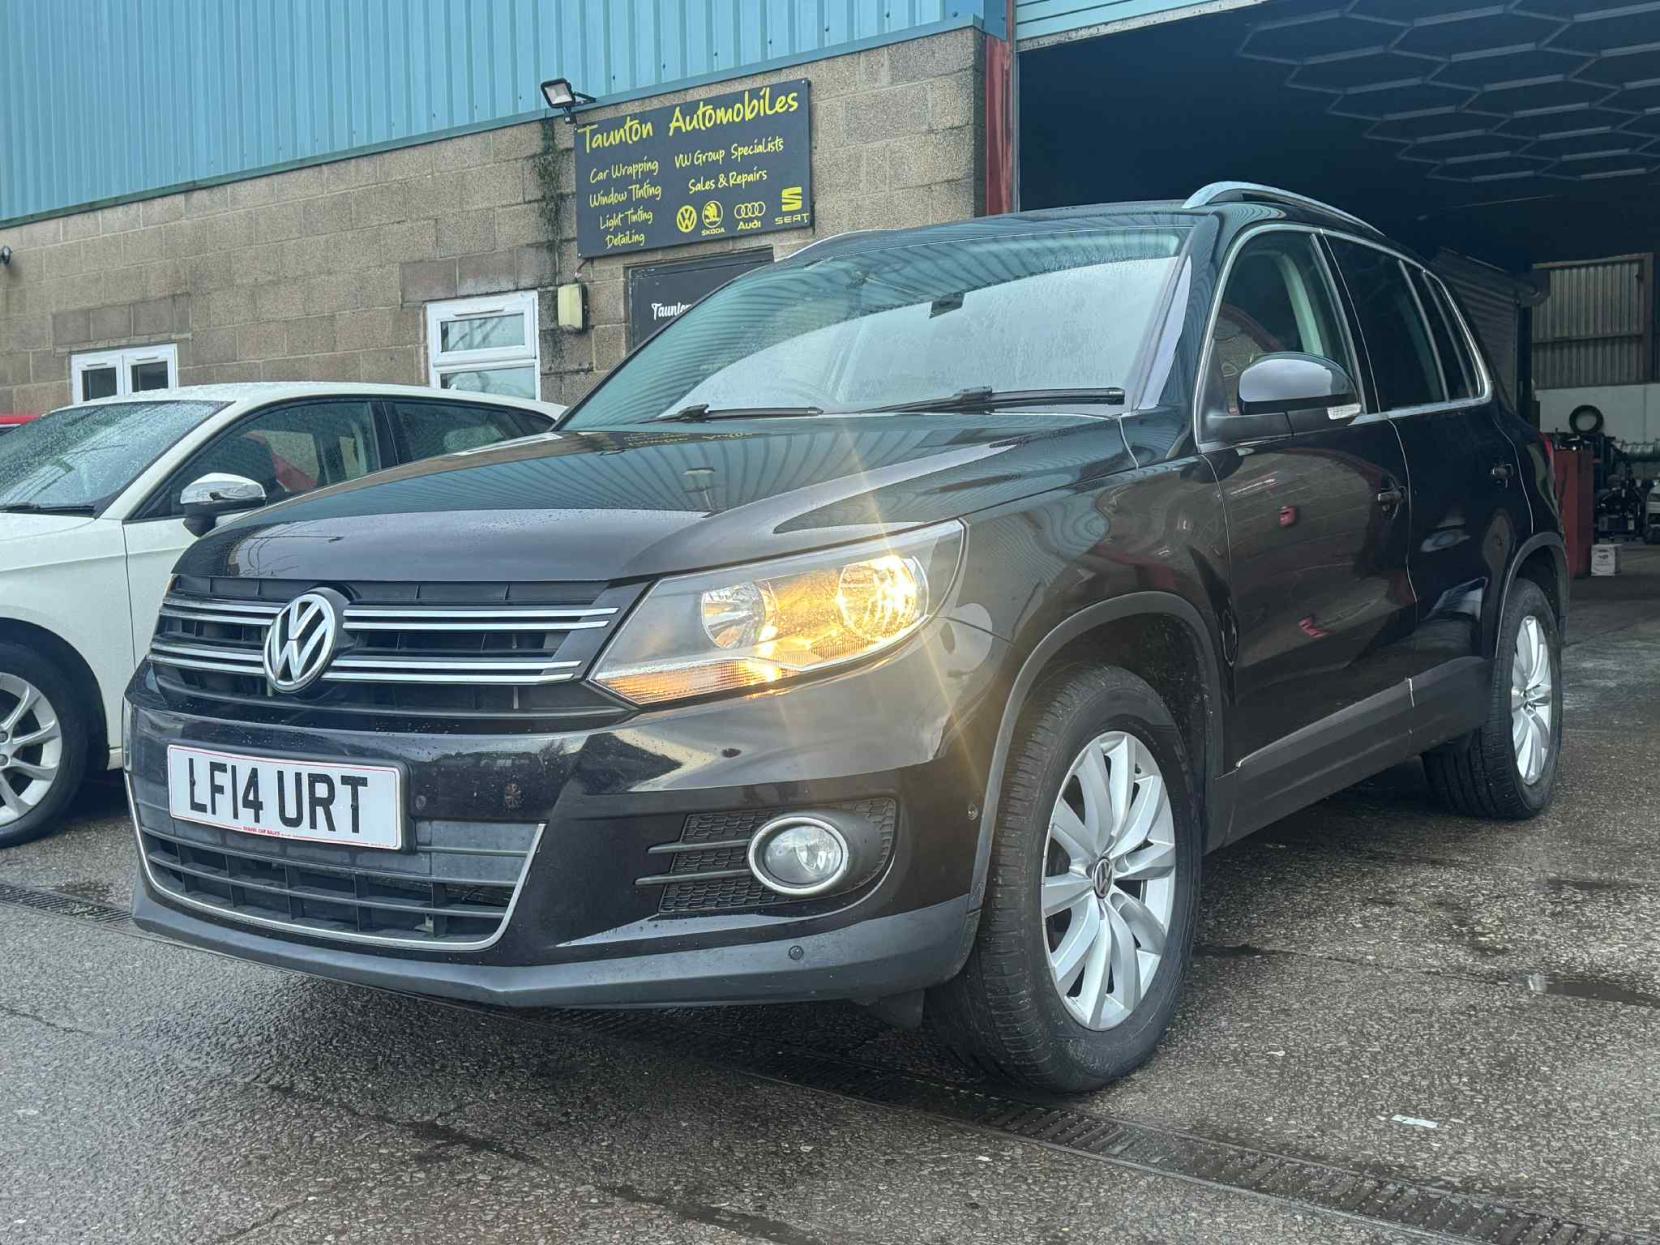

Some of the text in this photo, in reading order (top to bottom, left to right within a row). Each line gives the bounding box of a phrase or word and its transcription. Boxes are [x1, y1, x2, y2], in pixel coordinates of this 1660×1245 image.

[578, 87, 799, 154] Taunton Automobiles
[675, 136, 784, 168] VW Group Specialists
[589, 156, 659, 183] Car Wrapping
[688, 166, 768, 194] Sales & Repairs
[589, 179, 662, 208] Window Tinting
[600, 205, 653, 231] Light Tinting
[737, 219, 762, 231] Audi
[774, 213, 810, 225] SEAT
[605, 229, 645, 249] Detailing
[651, 302, 692, 320] Taunto
[188, 758, 368, 834] LF14 URT
